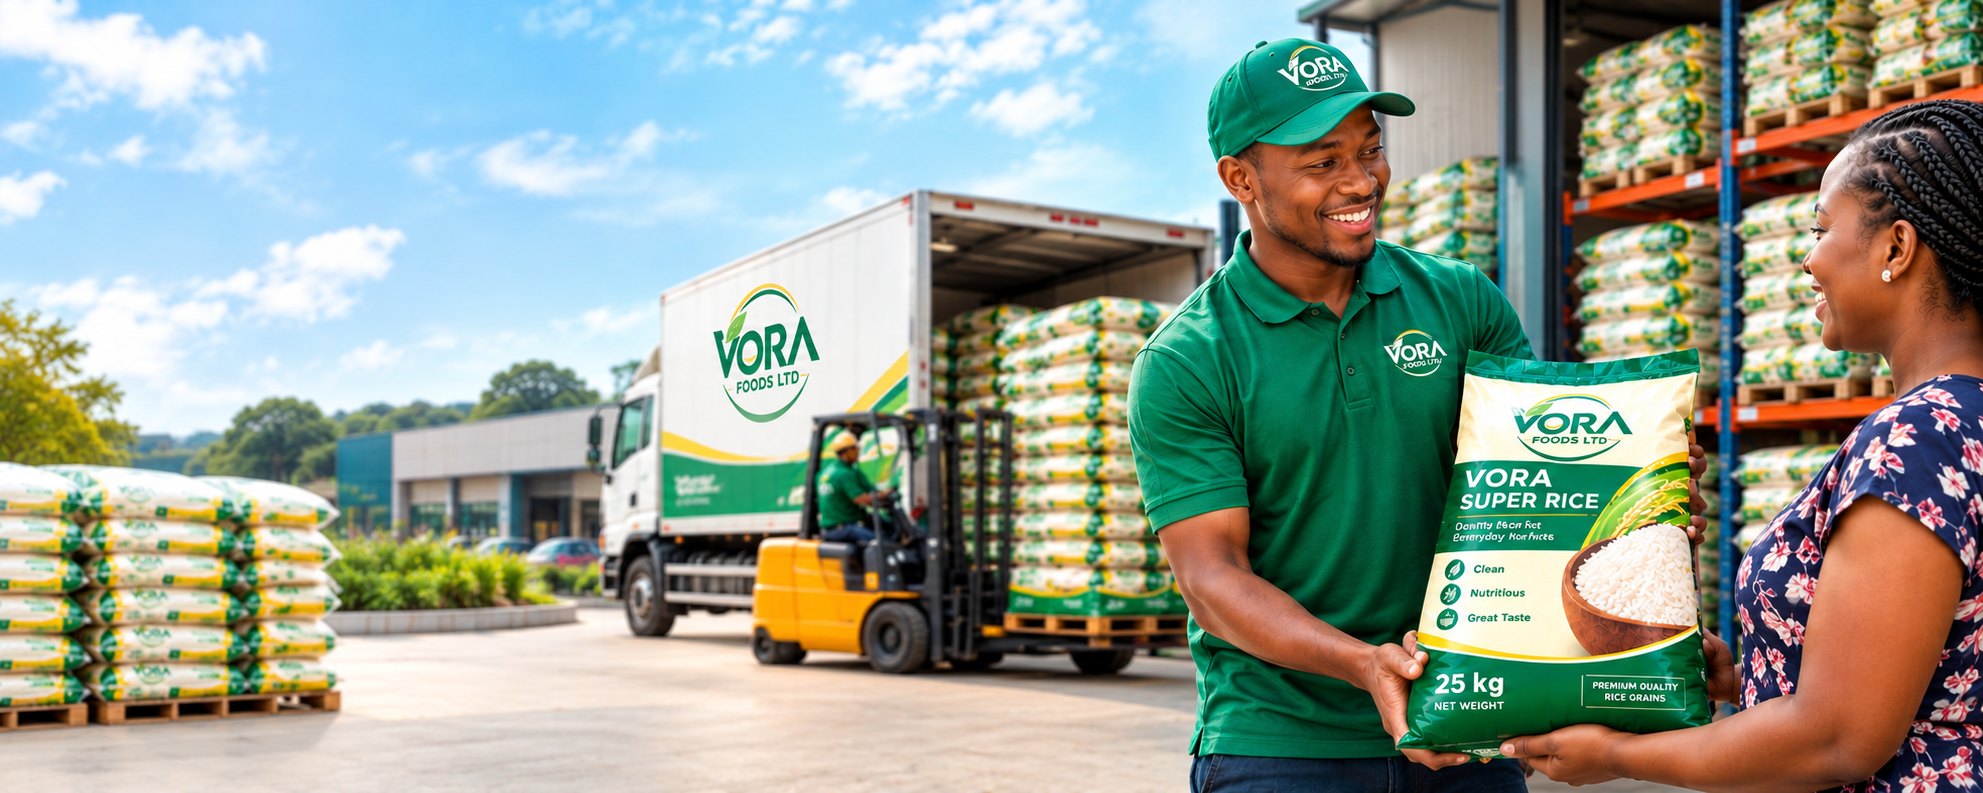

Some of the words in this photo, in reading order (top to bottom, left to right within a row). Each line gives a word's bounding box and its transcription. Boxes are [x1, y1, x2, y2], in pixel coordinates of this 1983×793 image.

[1277, 55, 1349, 86] VORA
[713, 315, 820, 379] VORA
[1383, 338, 1448, 364] VORA
[736, 375, 774, 394] FOODS
[777, 370, 800, 387] LTD
[1513, 409, 1633, 435] VORA
[1531, 436, 1579, 445] FOODS
[1583, 436, 1608, 445] LTD
[1465, 468, 1552, 488] VORA
[1459, 492, 1537, 510] SUPER
[1544, 493, 1600, 509] RICE
[1473, 564, 1505, 574] Clean
[1470, 588, 1526, 598] Nutritious
[1467, 613, 1498, 622] Great
[1501, 613, 1531, 622] Taste
[1434, 673, 1466, 695] 25
[1473, 672, 1504, 697] kg
[1434, 701, 1457, 711] NET
[1459, 701, 1505, 710] WEIGHT
[1604, 693, 1627, 701] RICE
